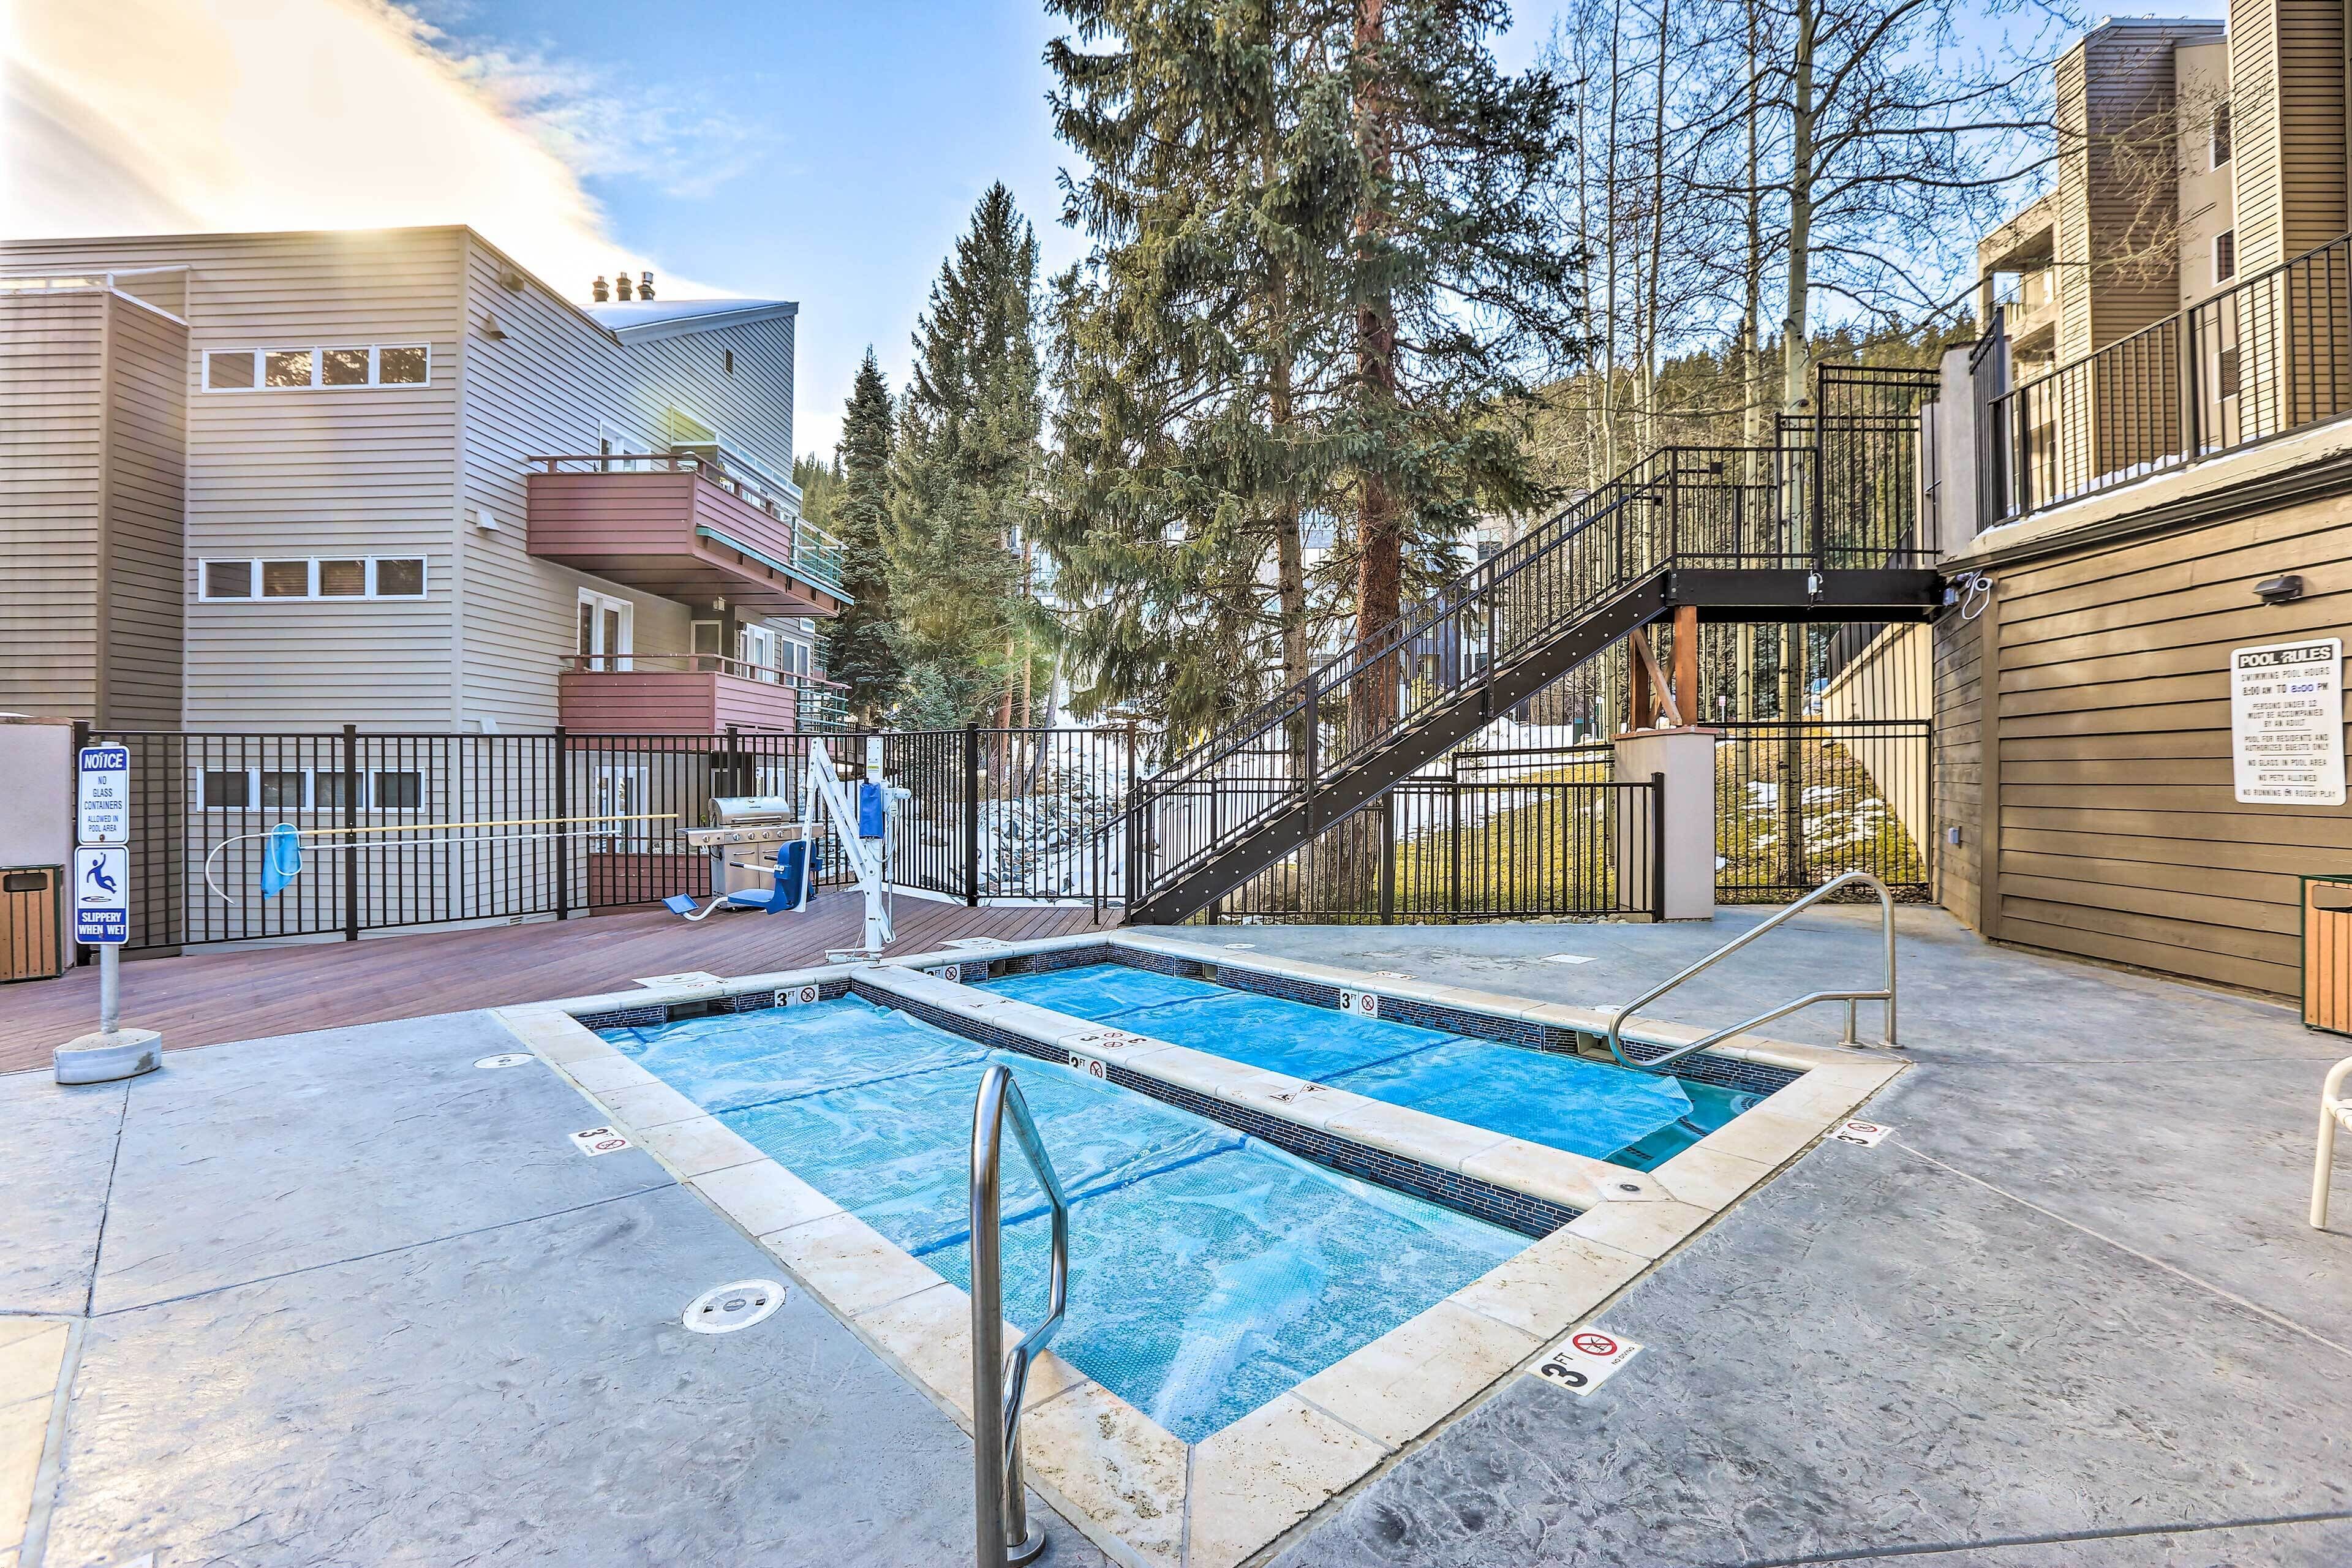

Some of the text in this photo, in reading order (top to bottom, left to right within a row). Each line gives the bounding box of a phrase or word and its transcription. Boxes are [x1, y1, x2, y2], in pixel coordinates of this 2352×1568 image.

[2240, 647, 2331, 668] POOL RULES
[2241, 667, 2330, 682] SWIMMING POOL HOURS
[2263, 686, 2272, 695] AM
[2277, 684, 2287, 693] TO
[2278, 709, 2323, 717] ACCOMPANIED
[85, 753, 124, 769] NOTICE
[98, 775, 107, 785] NO
[93, 788, 113, 797] GLASS
[85, 801, 123, 810] CONTAINERS
[81, 912, 122, 922] SLIPPERY
[78, 924, 126, 935] WHEN WET
[777, 992, 788, 1007] 3
[1342, 993, 1351, 1009] 3
[1079, 1058, 1086, 1067] FT
[578, 1129, 608, 1138] 3
[1838, 1135, 1869, 1145] 3
[1620, 1346, 1635, 1359] DIVING
[1541, 1352, 1588, 1388] 3 FT
